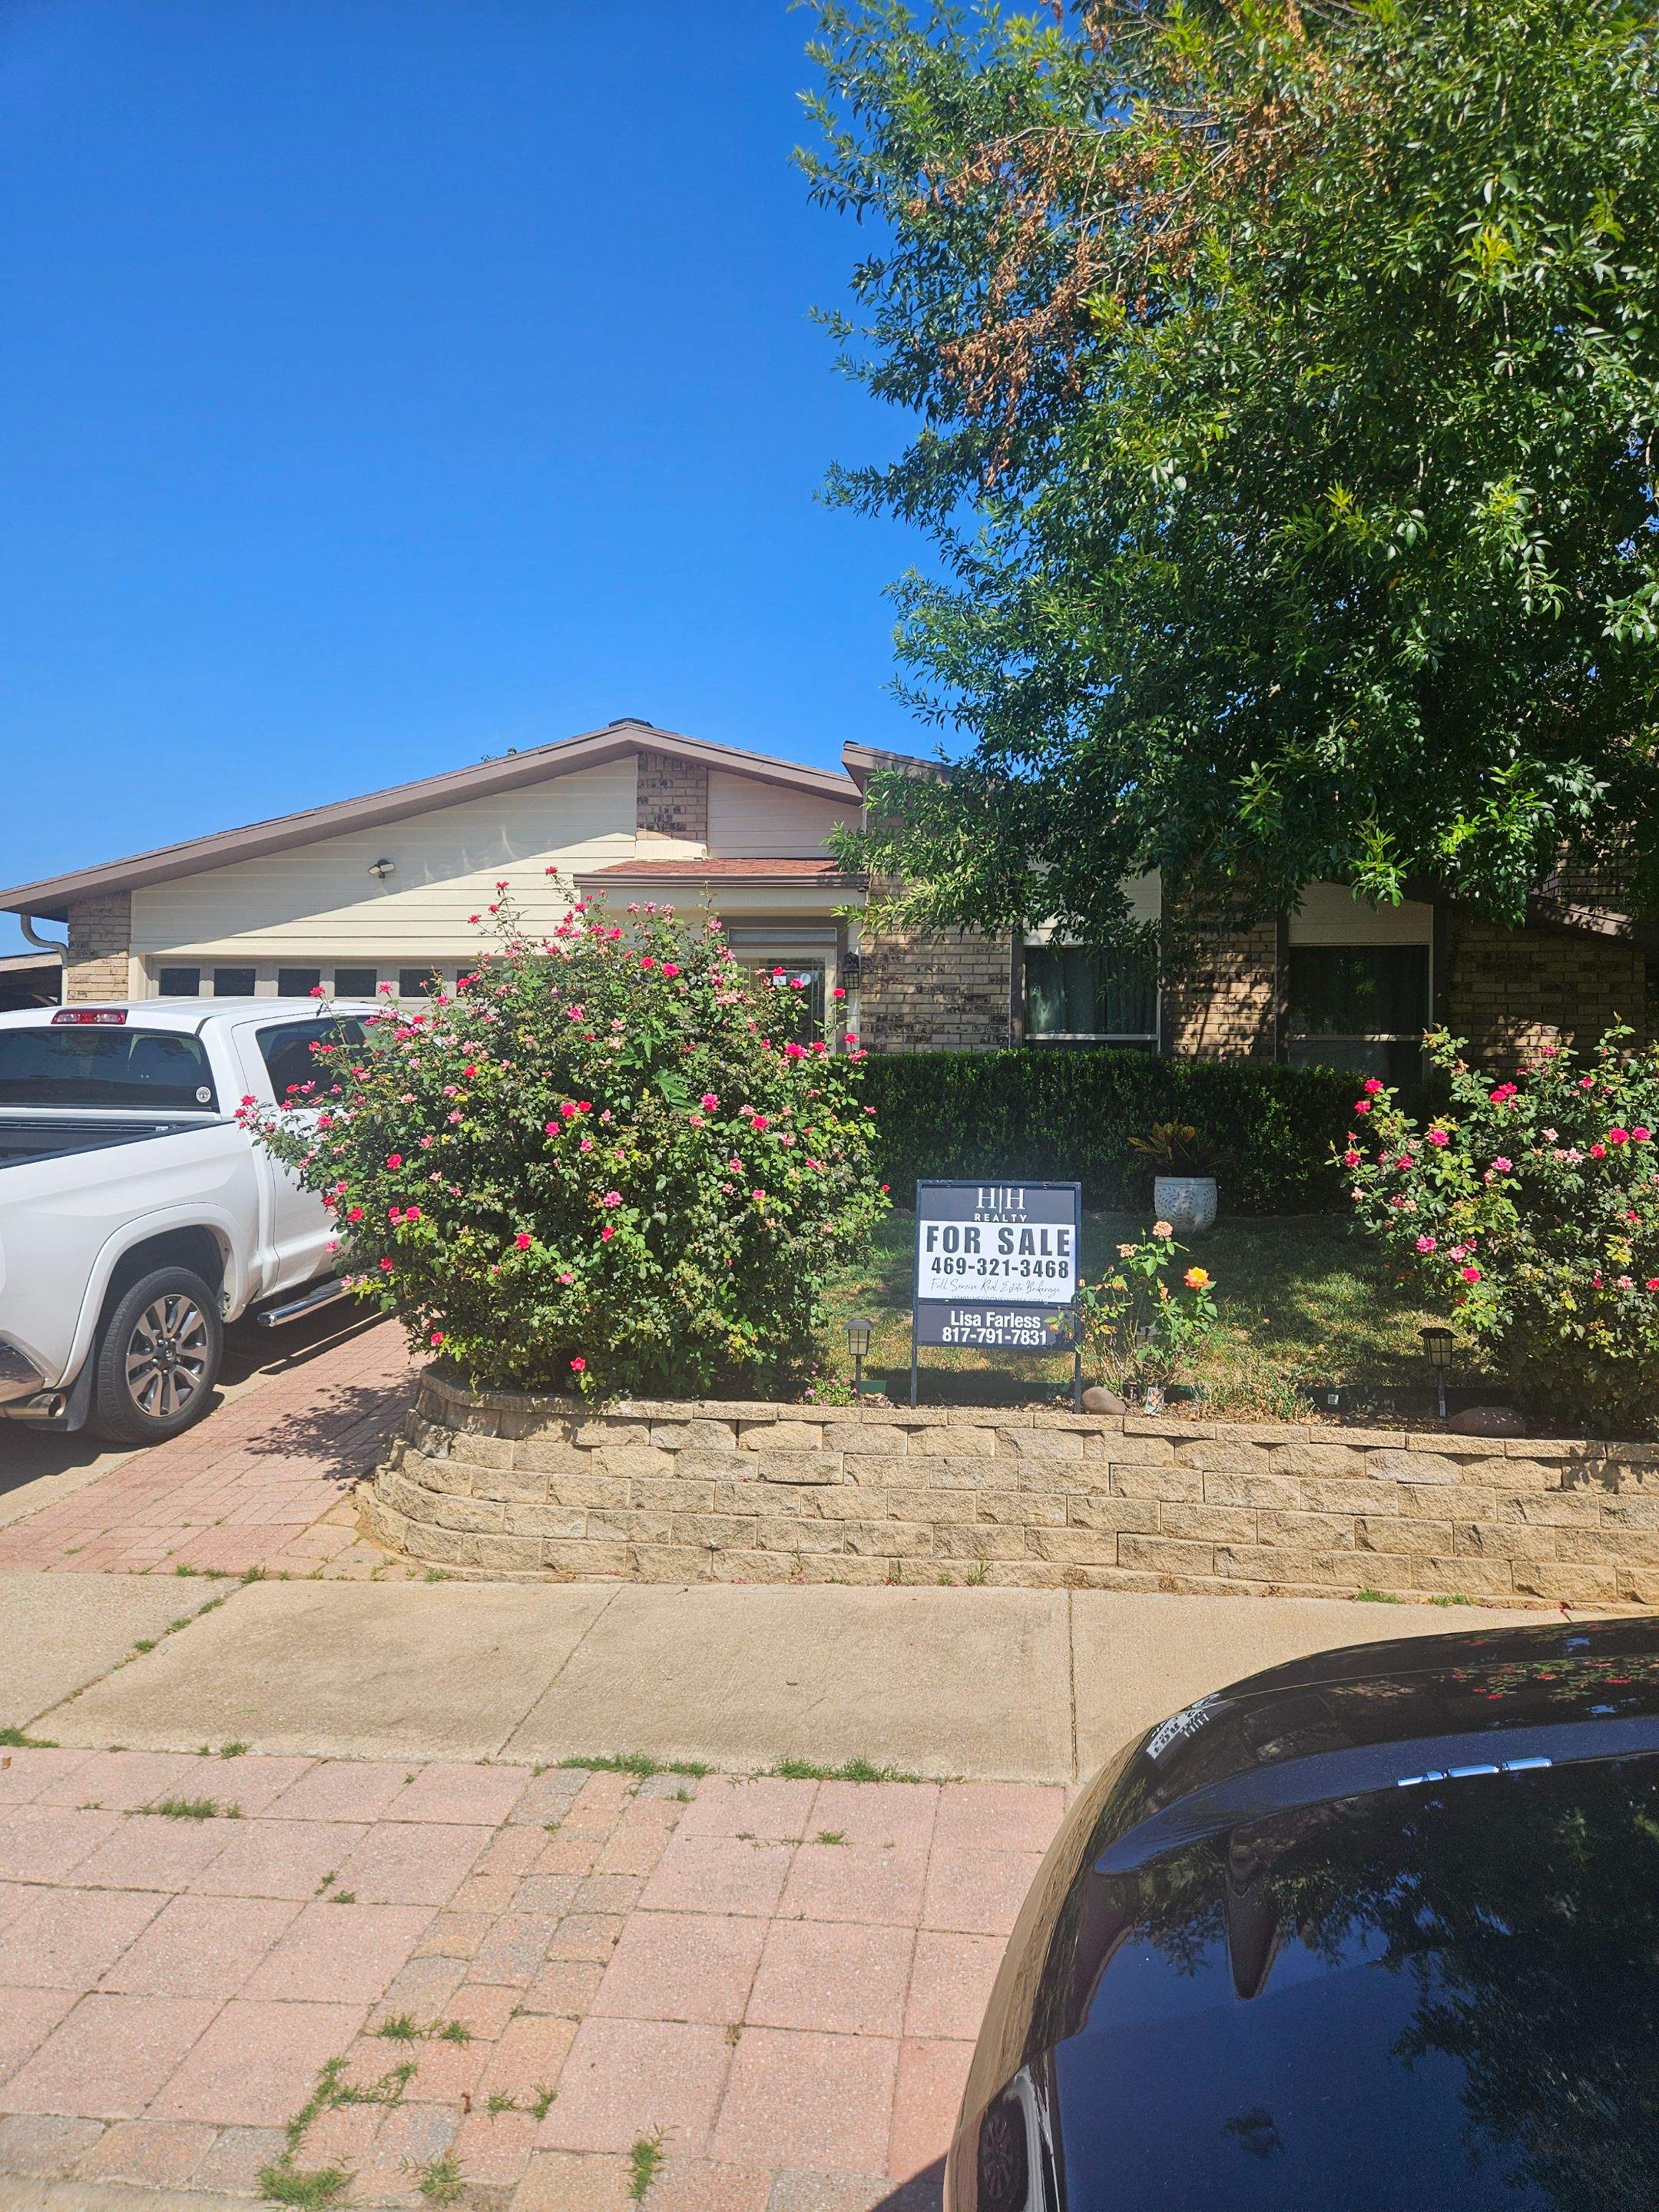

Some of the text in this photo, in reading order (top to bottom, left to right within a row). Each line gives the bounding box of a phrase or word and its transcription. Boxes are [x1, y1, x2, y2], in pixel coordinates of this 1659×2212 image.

[974, 1213, 1028, 1223] REALTY
[926, 1225, 1070, 1257] FOR SALE
[931, 1257, 1069, 1279] 469-321-3468
[931, 1277, 1061, 1298] Full Service Real Estate Brokerage
[950, 1310, 1041, 1330] Lisa Farless
[942, 1326, 1047, 1346] 817-791-7831
